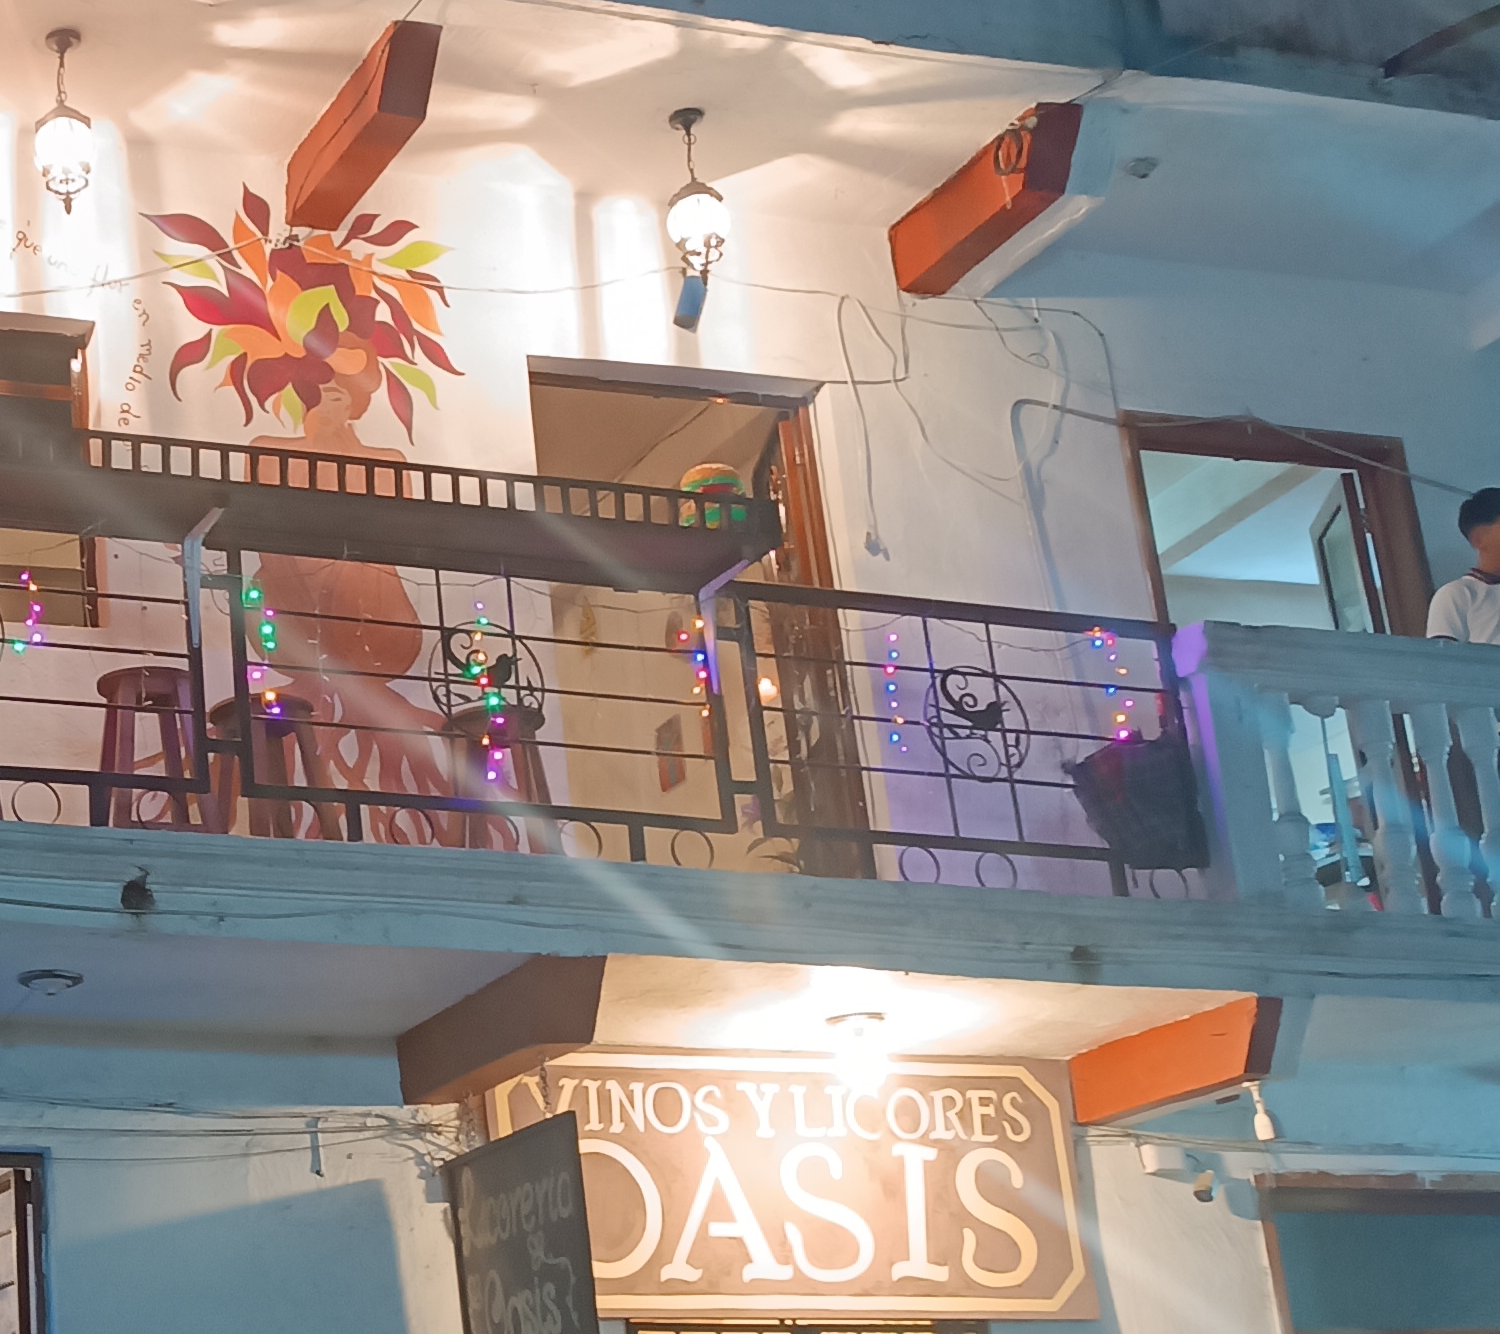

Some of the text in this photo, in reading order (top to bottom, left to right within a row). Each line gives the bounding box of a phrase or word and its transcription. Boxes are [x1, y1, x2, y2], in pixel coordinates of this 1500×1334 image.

[124, 339, 153, 392] medio
[117, 403, 142, 429] de
[520, 1075, 1034, 1143] VINOS Y LICORES
